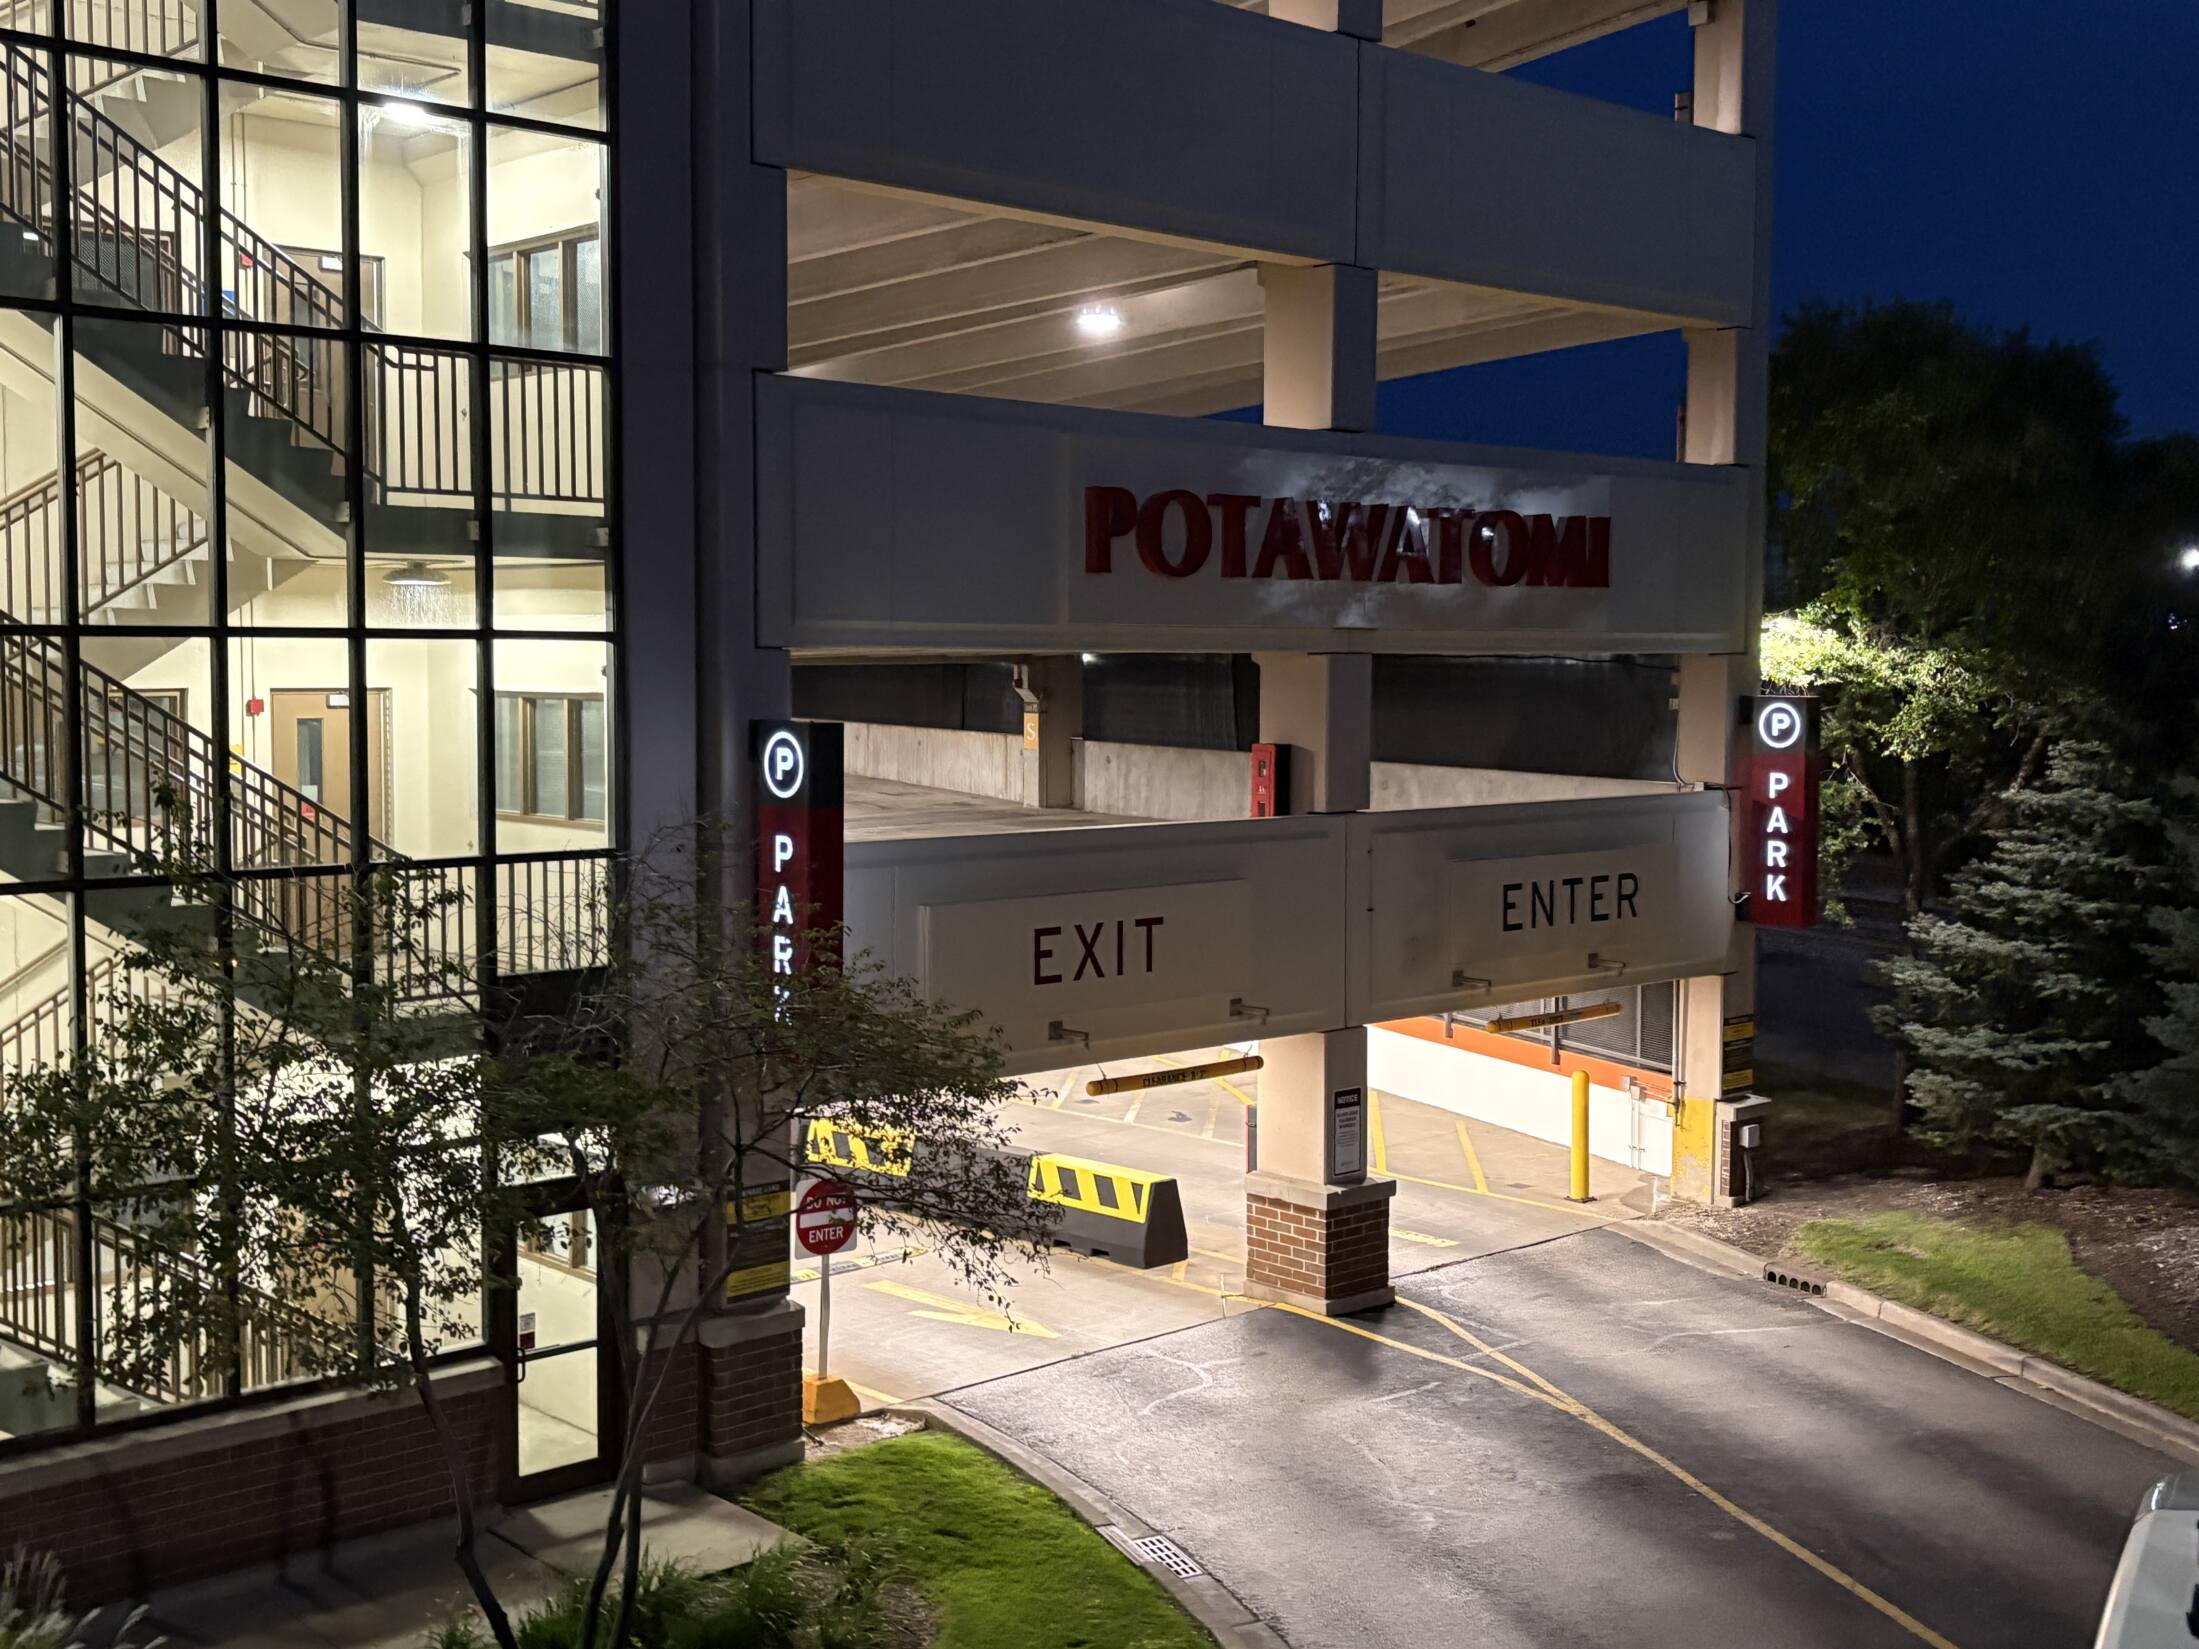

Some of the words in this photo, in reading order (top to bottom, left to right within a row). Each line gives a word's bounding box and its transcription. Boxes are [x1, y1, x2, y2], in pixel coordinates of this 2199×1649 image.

[1085, 485, 1611, 588] POTAWATOMI
[1026, 722, 1036, 741] S
[1771, 713, 1791, 736] P
[774, 747, 794, 780] P
[1766, 772, 1789, 902] PARK
[1502, 872, 1639, 932] ENTER
[1033, 916, 1164, 986] EXIT
[808, 1226, 844, 1244] ENTER
